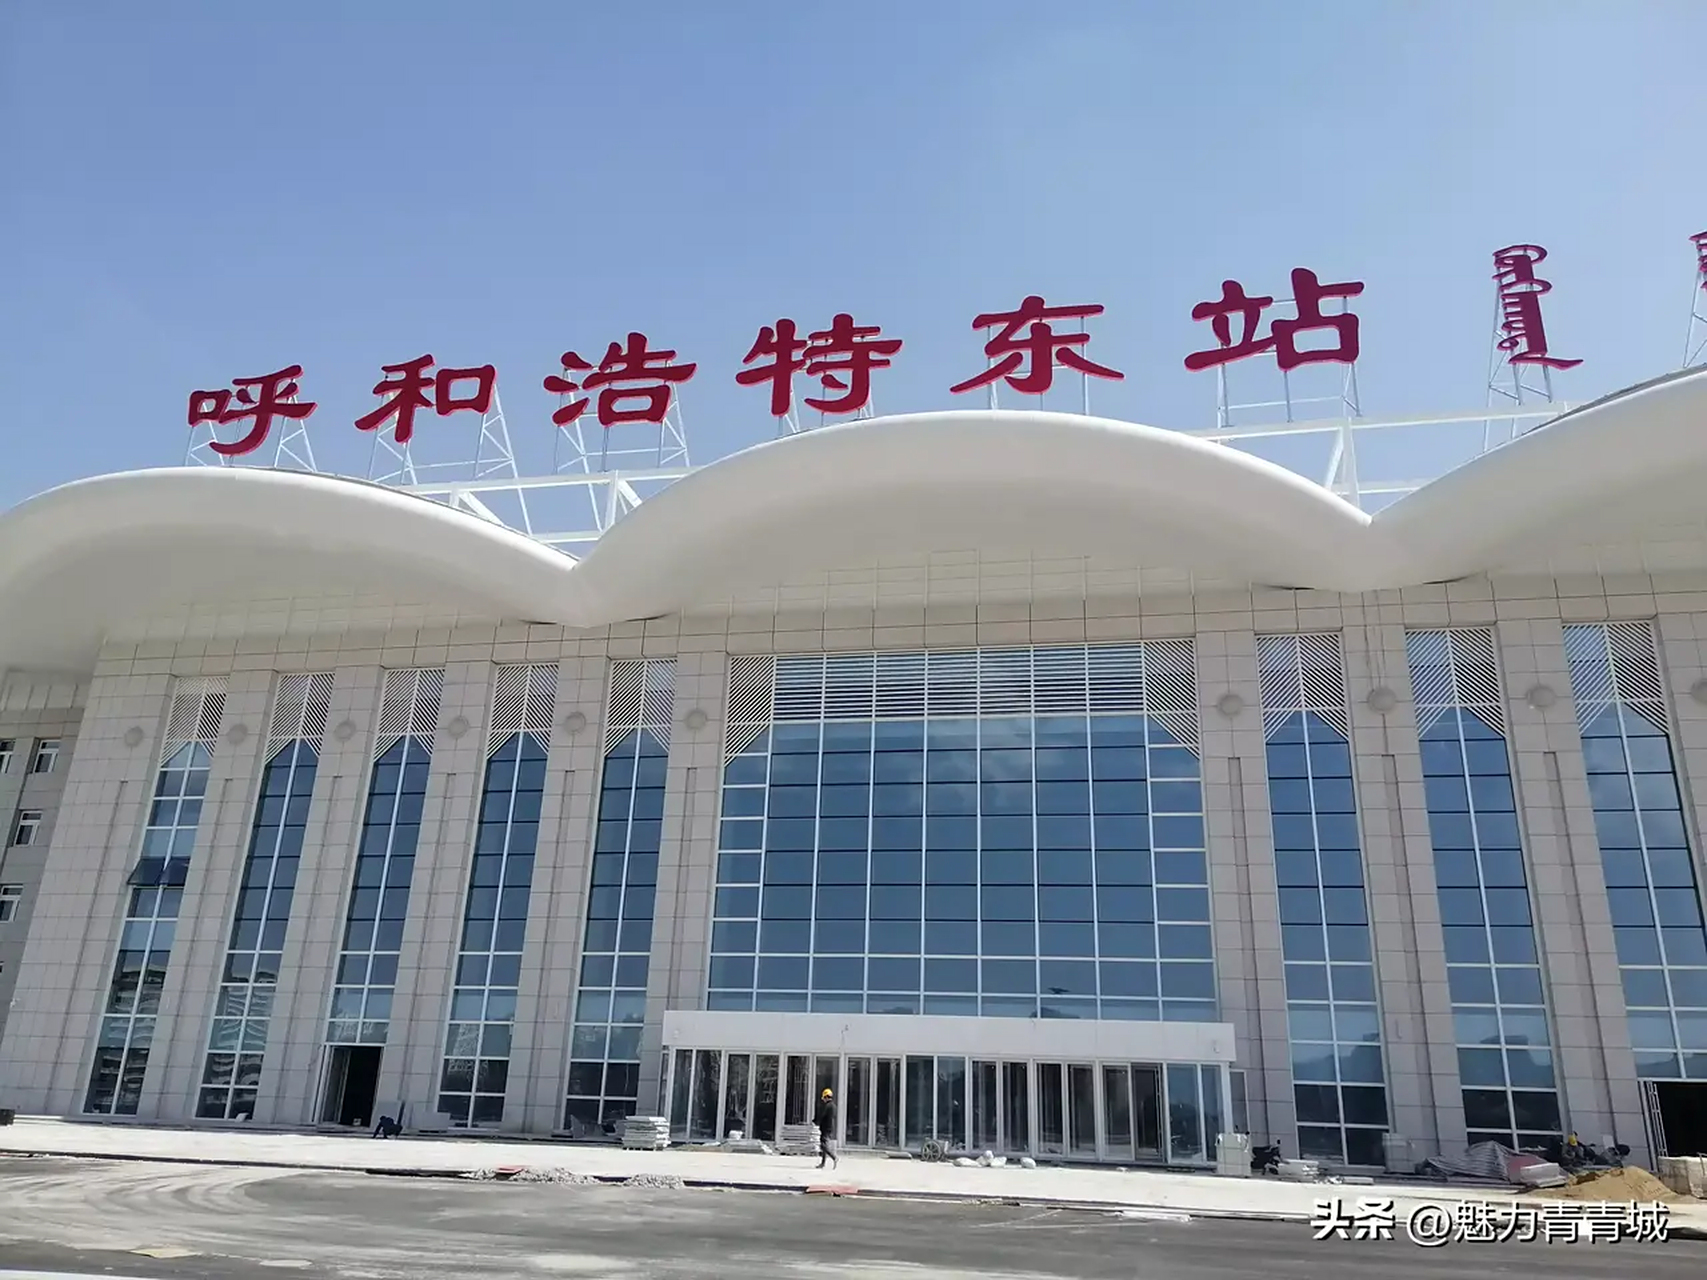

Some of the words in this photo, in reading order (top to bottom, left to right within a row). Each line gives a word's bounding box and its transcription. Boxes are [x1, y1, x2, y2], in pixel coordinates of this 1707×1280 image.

[188, 267, 1365, 456] 呼和浩特东站
